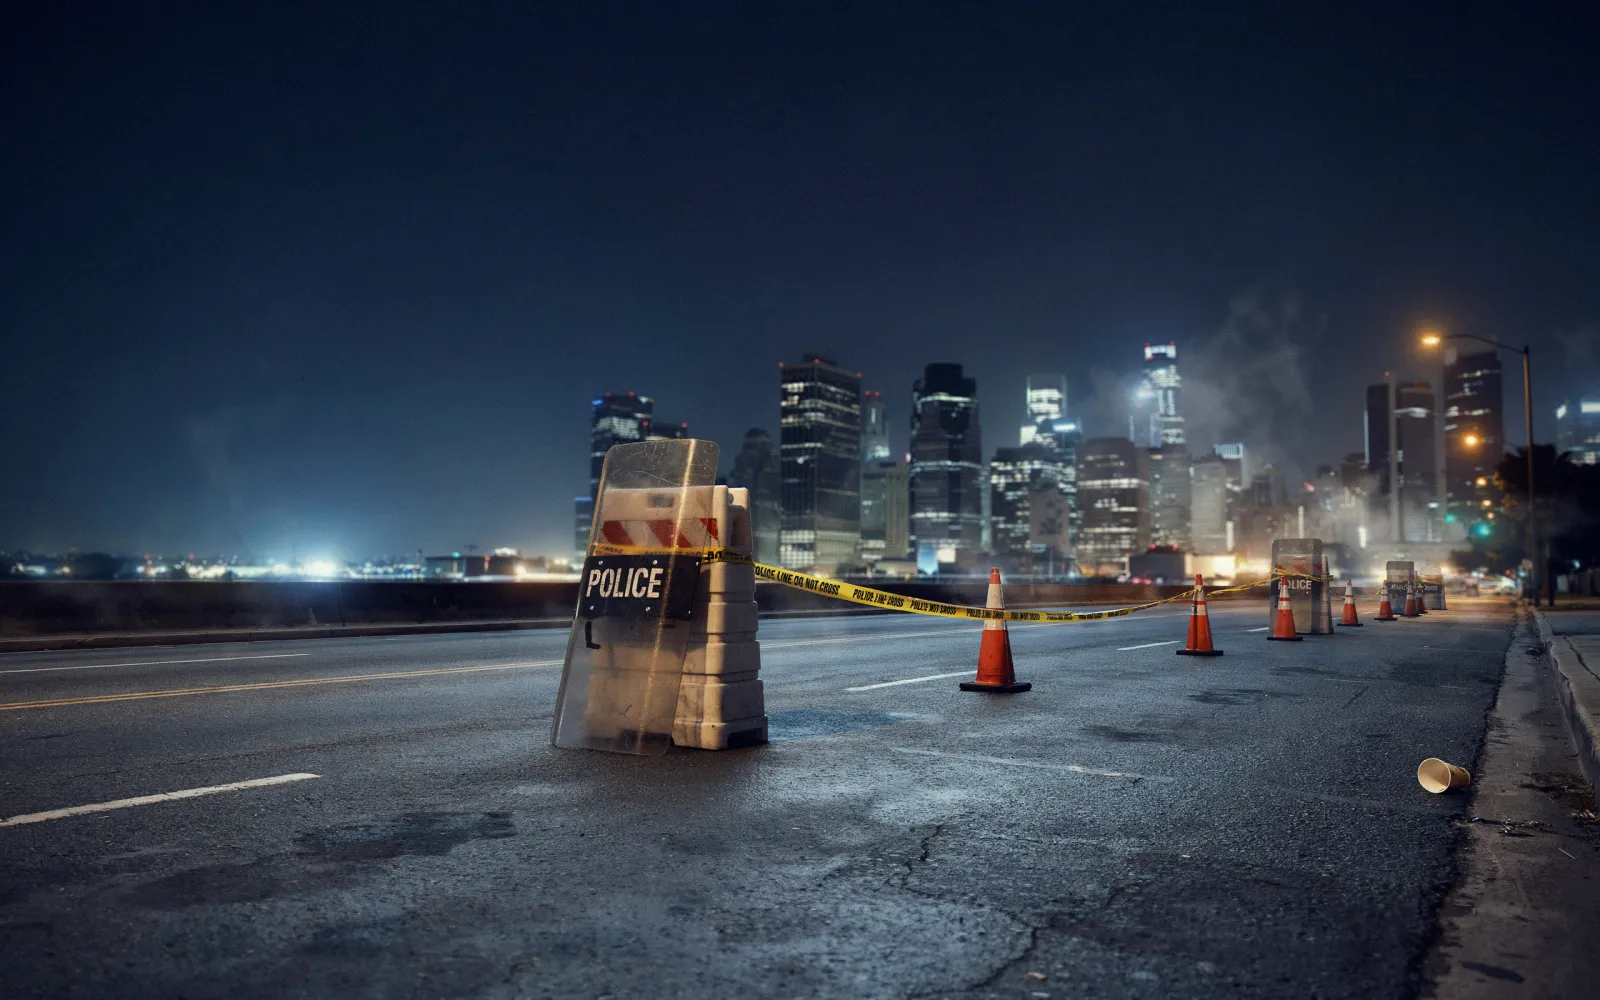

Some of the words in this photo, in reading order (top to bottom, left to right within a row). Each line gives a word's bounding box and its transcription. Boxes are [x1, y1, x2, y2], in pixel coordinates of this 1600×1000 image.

[586, 567, 664, 598] POLICE
[755, 566, 775, 580] OLICE
[777, 571, 793, 584] LINE
[794, 575, 804, 587] DO
[805, 578, 819, 590] NOT
[820, 581, 840, 595] CROSS
